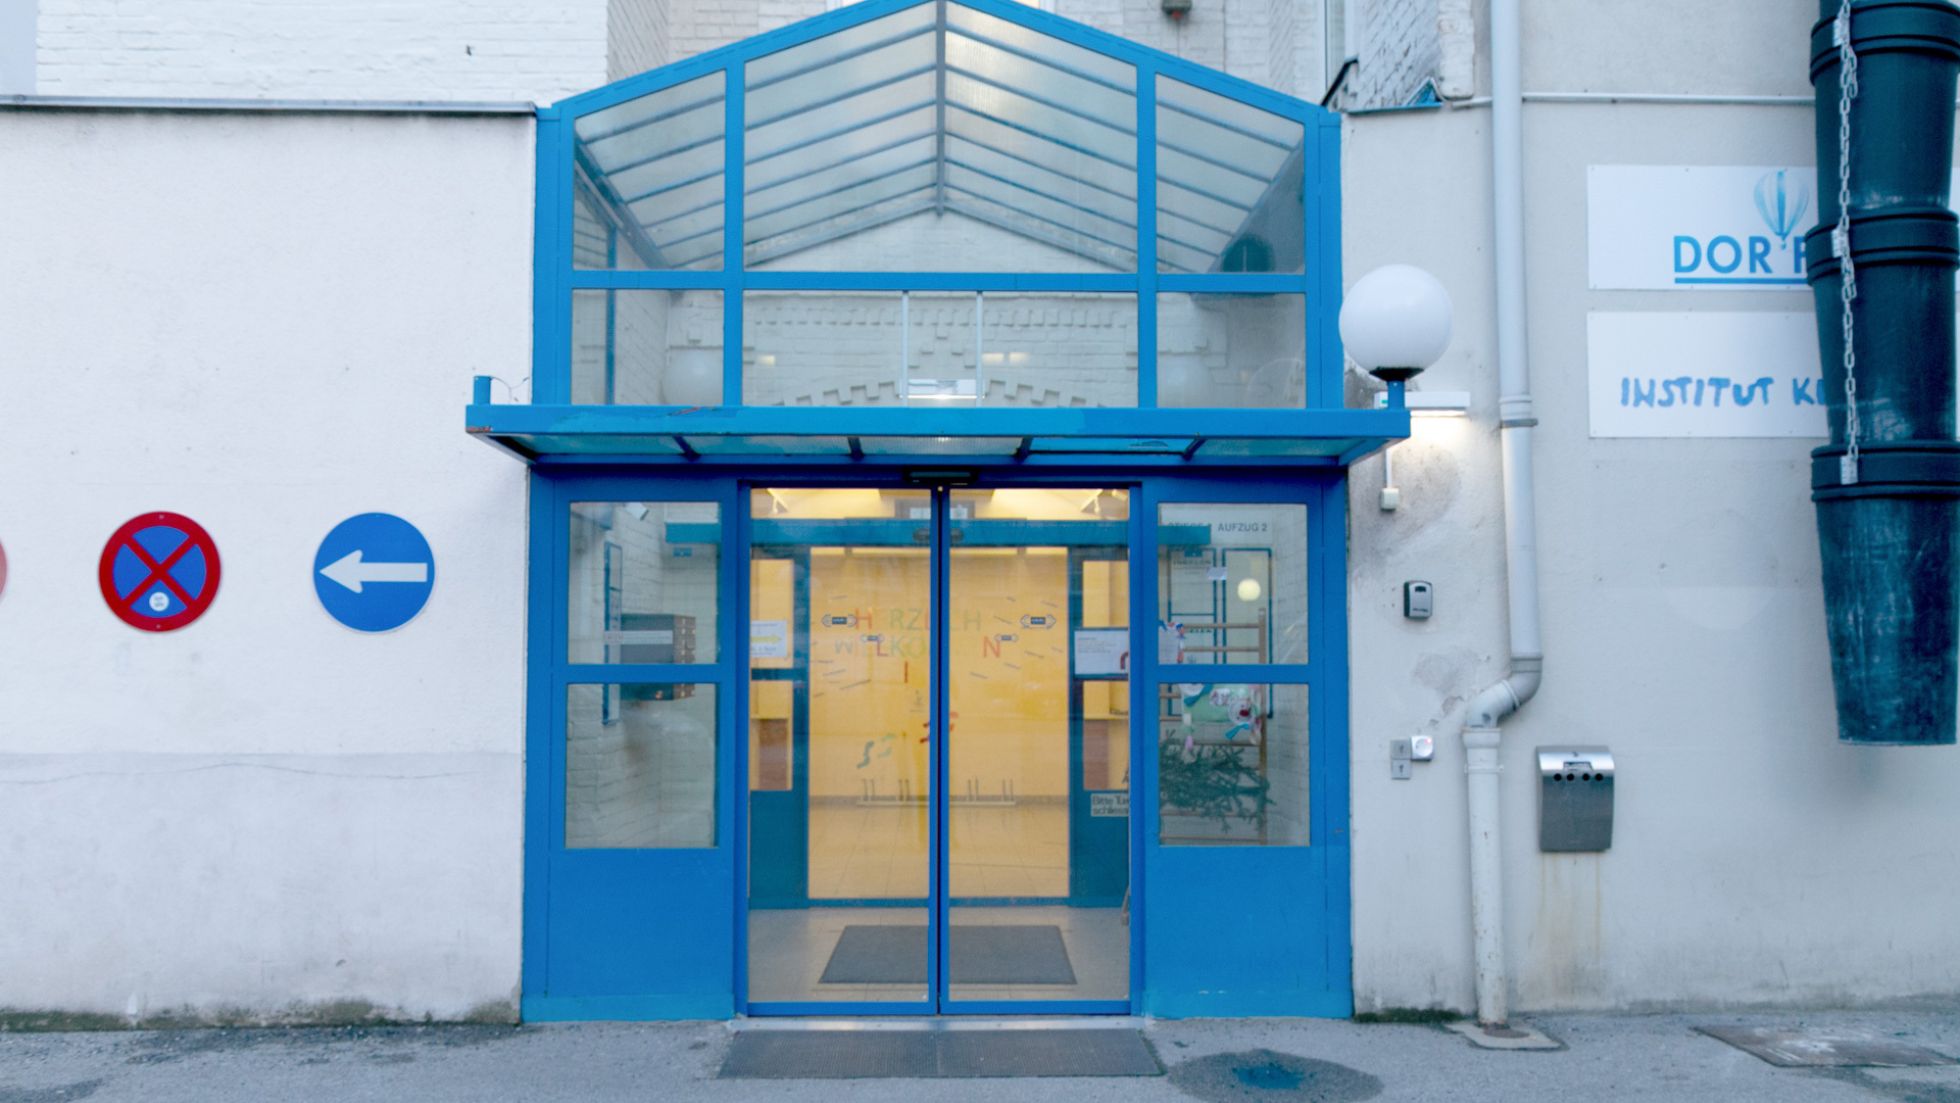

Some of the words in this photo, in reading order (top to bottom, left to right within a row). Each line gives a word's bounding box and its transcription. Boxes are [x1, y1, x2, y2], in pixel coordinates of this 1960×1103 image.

[1674, 235, 1772, 273] DOR
[1621, 376, 1774, 407] INSTITUT
[1218, 522, 1259, 531] AUFZUG
[1261, 522, 1268, 531] 2
